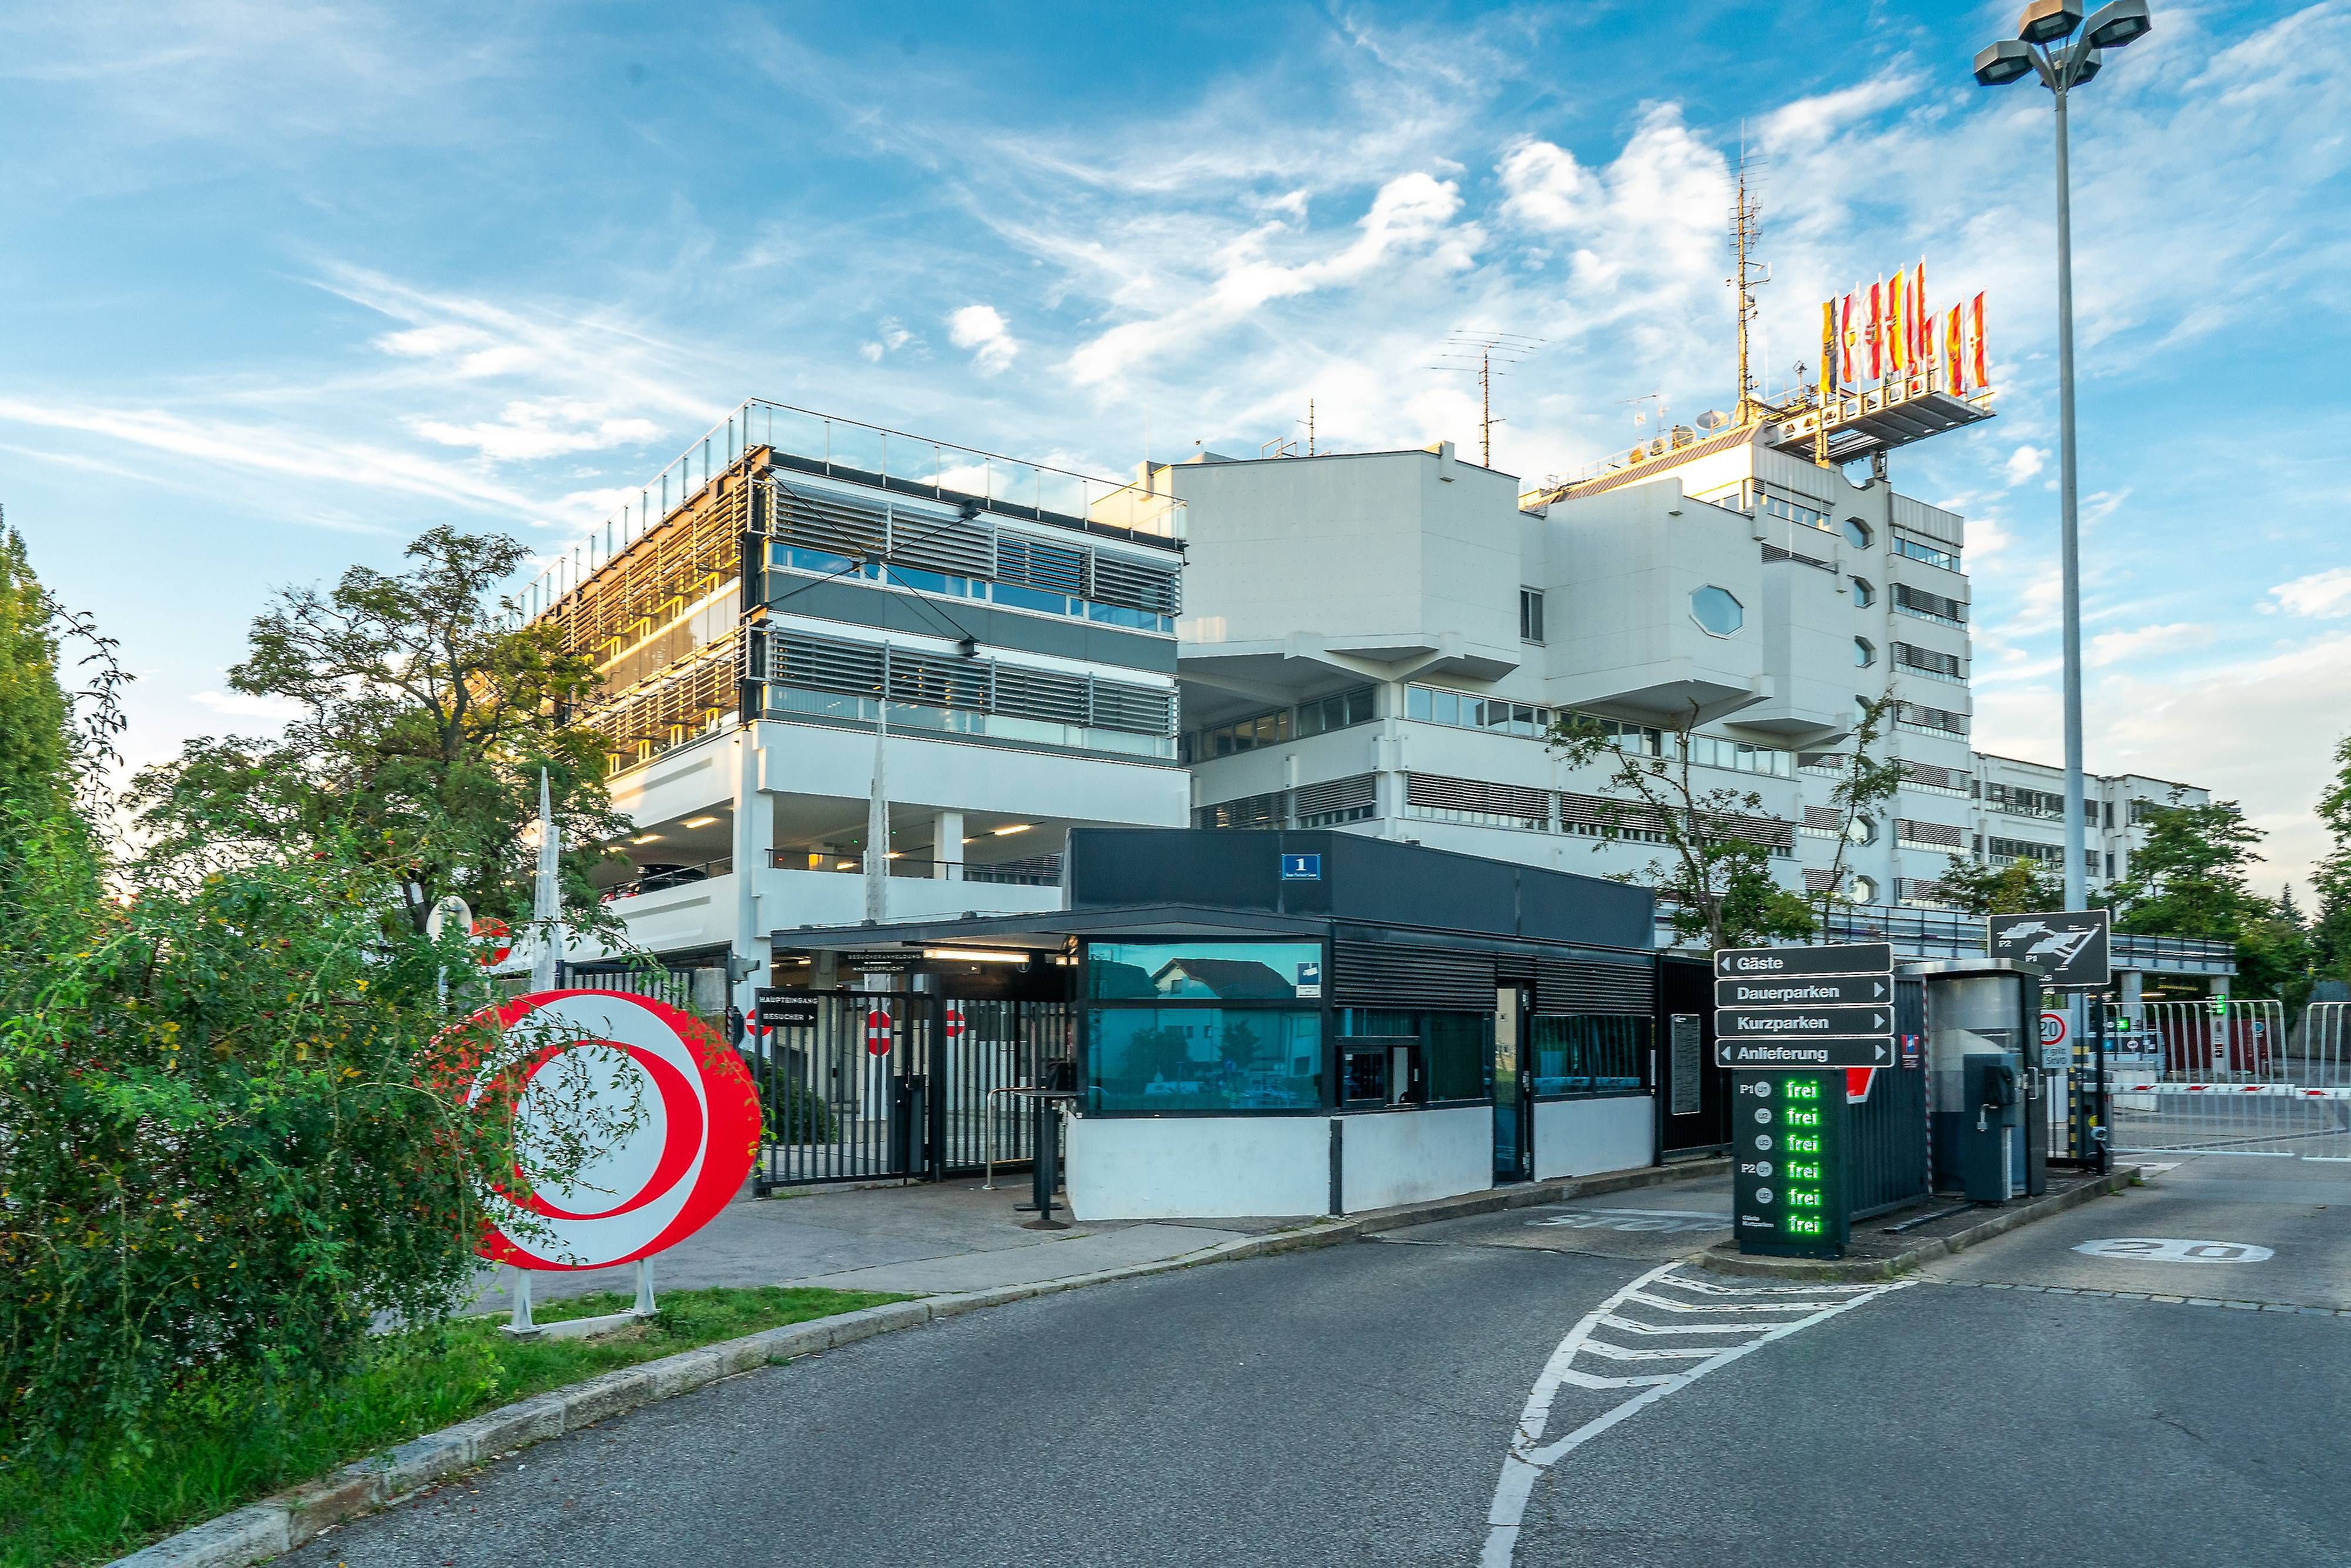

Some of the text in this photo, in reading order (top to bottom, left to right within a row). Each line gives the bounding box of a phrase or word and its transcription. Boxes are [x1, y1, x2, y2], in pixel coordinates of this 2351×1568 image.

[1295, 858, 1307, 871] 1
[1736, 956, 1784, 970] Gäste
[1737, 985, 1840, 1001] Dauerparken
[1737, 1016, 1829, 1032] Kurzparken
[2041, 1021, 2057, 1037] 20
[1737, 1047, 1828, 1063] Anlieferung
[1740, 1084, 1754, 1094] P1
[1786, 1081, 1817, 1097] frei
[1787, 1108, 1817, 1124] frei
[1787, 1135, 1817, 1151] frei
[1741, 1164, 1756, 1173] P2
[1788, 1162, 1818, 1178] frei
[1789, 1189, 1818, 1205] frei
[1789, 1215, 1819, 1232] frei
